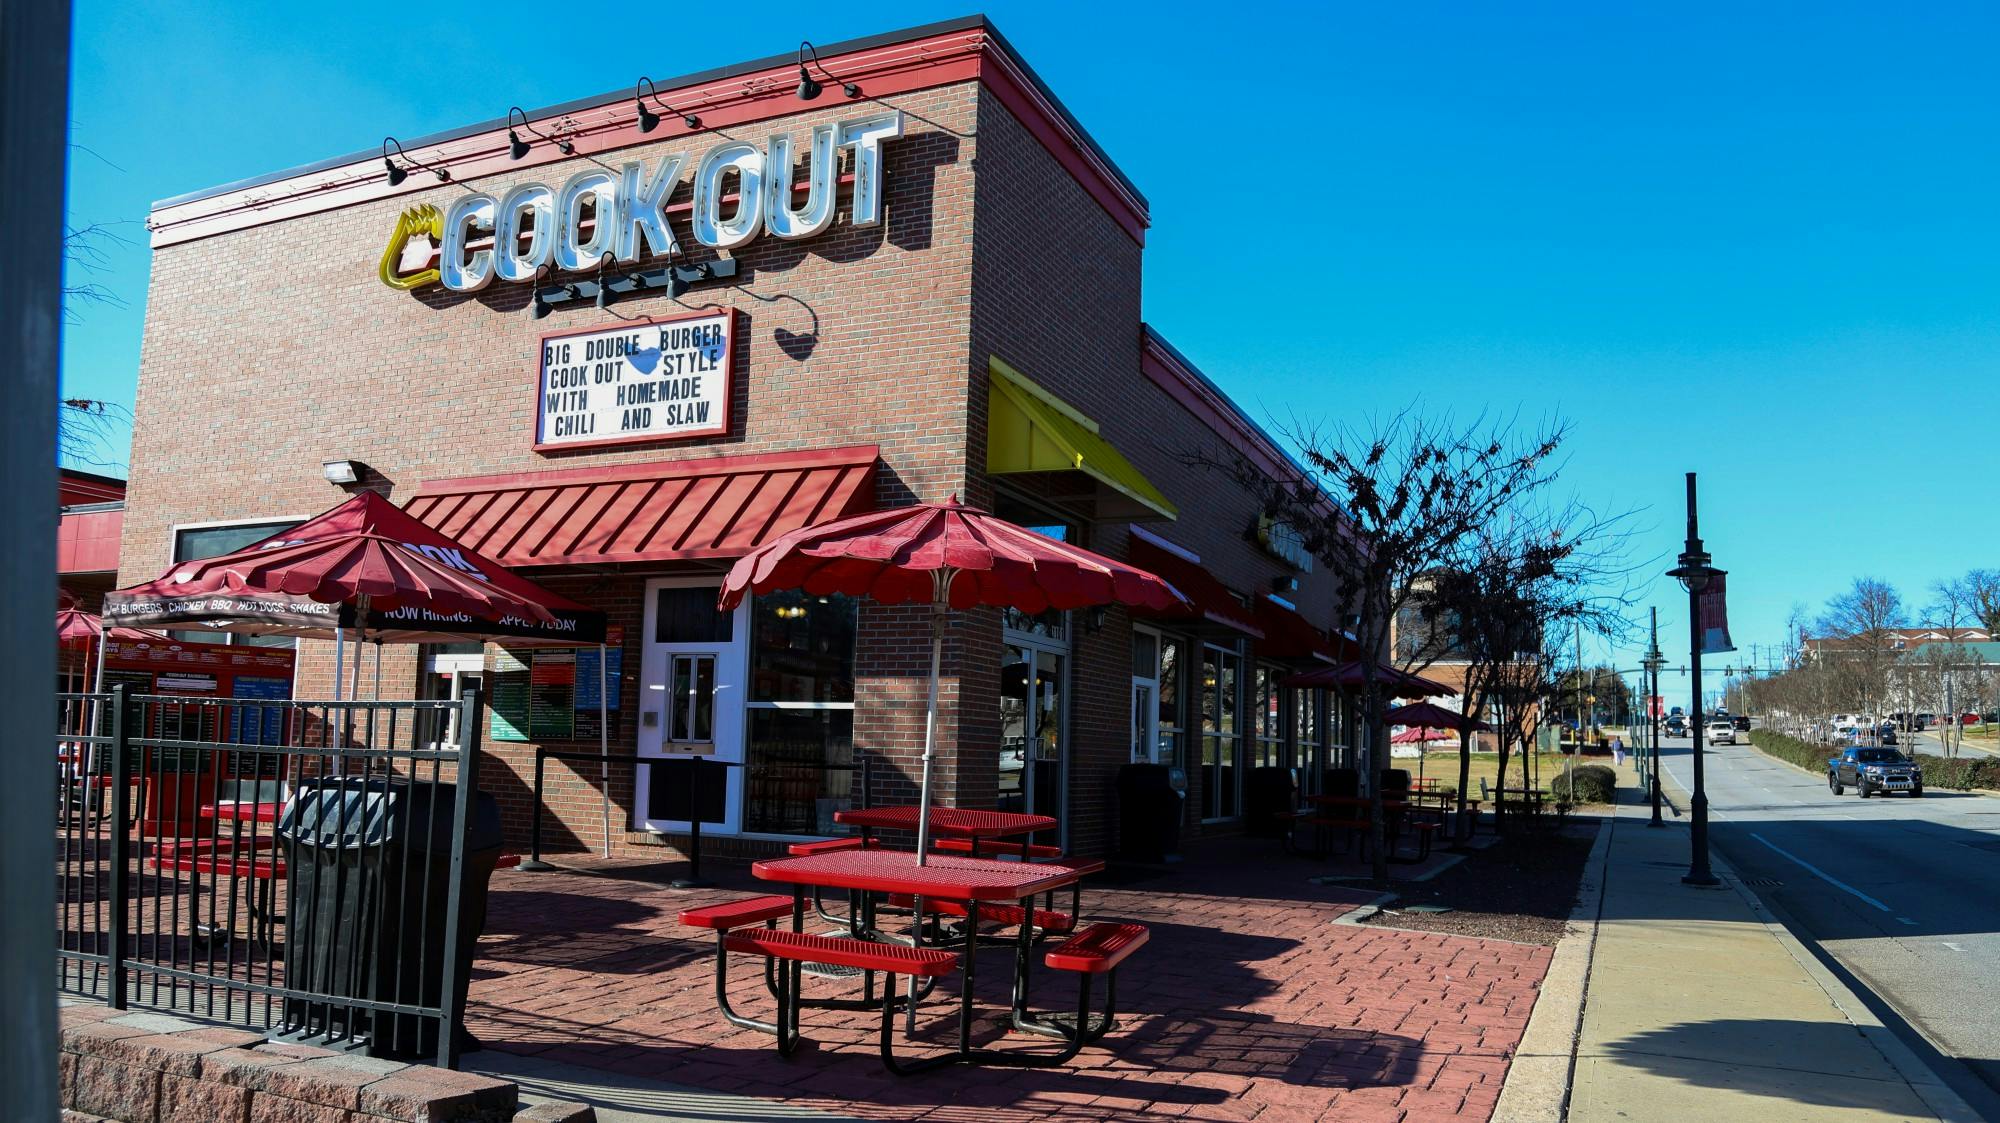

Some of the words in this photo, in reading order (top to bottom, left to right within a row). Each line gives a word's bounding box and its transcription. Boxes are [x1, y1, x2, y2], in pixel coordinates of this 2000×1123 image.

[440, 152, 689, 292] COOK
[692, 110, 904, 249] OUT
[546, 344, 570, 366] BIG
[586, 334, 640, 361] DOUBLE
[660, 324, 721, 351] BURGER
[551, 365, 588, 389] COOK
[595, 361, 624, 384] OUT
[663, 349, 718, 376] STYLE
[547, 389, 587, 413] WITH
[616, 376, 701, 406] HOMEMADE
[555, 413, 595, 436] CHILI
[621, 407, 651, 430] AND
[667, 400, 710, 425] SLAW
[121, 603, 163, 614] BURGERS
[169, 600, 207, 612] CHICKEN
[210, 599, 232, 610] BBQ
[236, 600, 257, 611] HOT
[260, 601, 286, 613] DOGS
[290, 603, 330, 614] SHAKES
